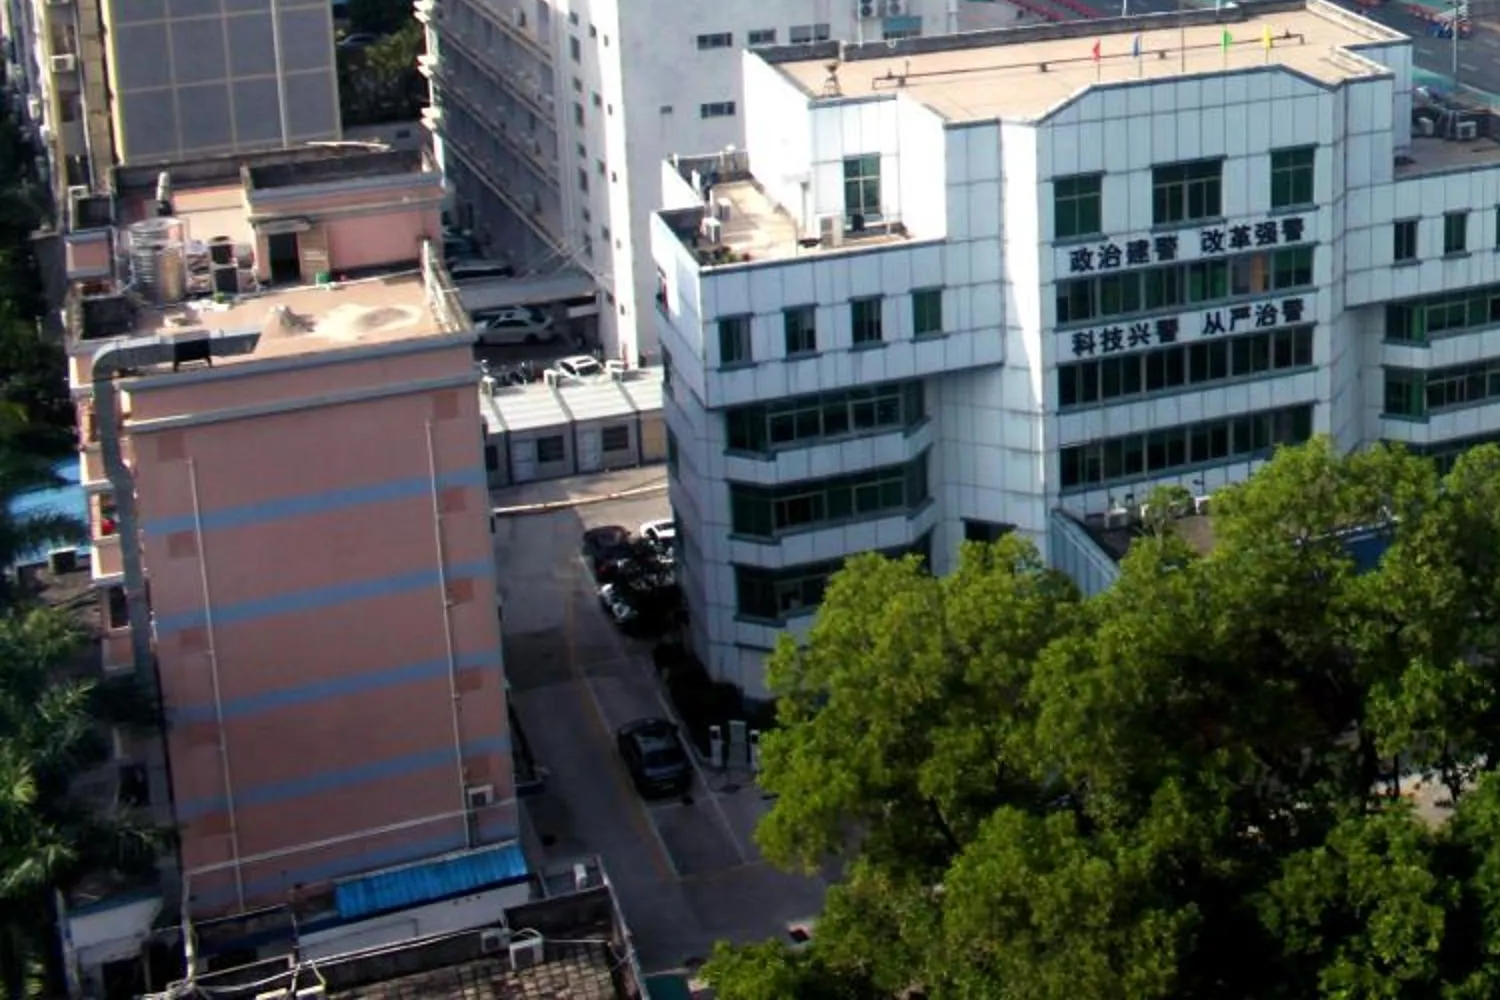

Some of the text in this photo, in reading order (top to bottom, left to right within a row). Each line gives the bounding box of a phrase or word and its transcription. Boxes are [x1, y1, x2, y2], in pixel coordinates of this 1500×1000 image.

[1069, 217, 1305, 273] 政治建警 改革强警
[1071, 297, 1305, 356] 科技兴警 从严治警
